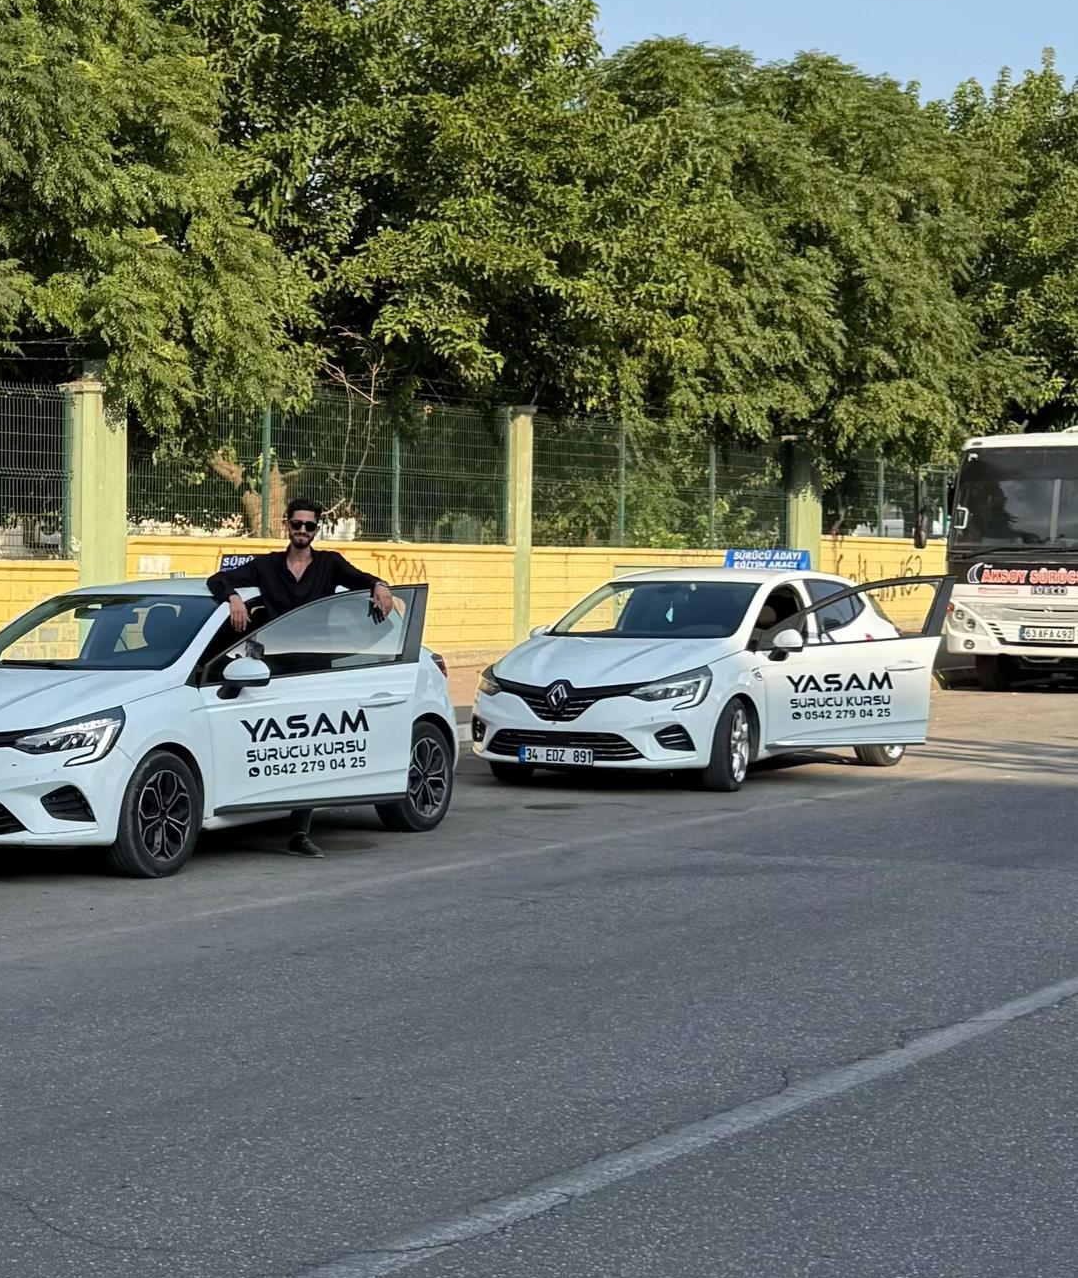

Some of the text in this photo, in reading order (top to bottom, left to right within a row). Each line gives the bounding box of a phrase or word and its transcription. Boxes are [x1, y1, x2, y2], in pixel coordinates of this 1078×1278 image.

[773, 551, 802, 560] ADAYI
[981, 569, 1029, 584] AKSOY
[1030, 586, 1067, 596] IVECO
[846, 695, 891, 707] KURSU
[805, 708, 891, 720] 0542 279 04 25
[246, 739, 367, 763] SÜRÜCÜ KURSU
[526, 748, 592, 764] 34 EDZ 891
[264, 756, 367, 777] 0542 279 04 25
